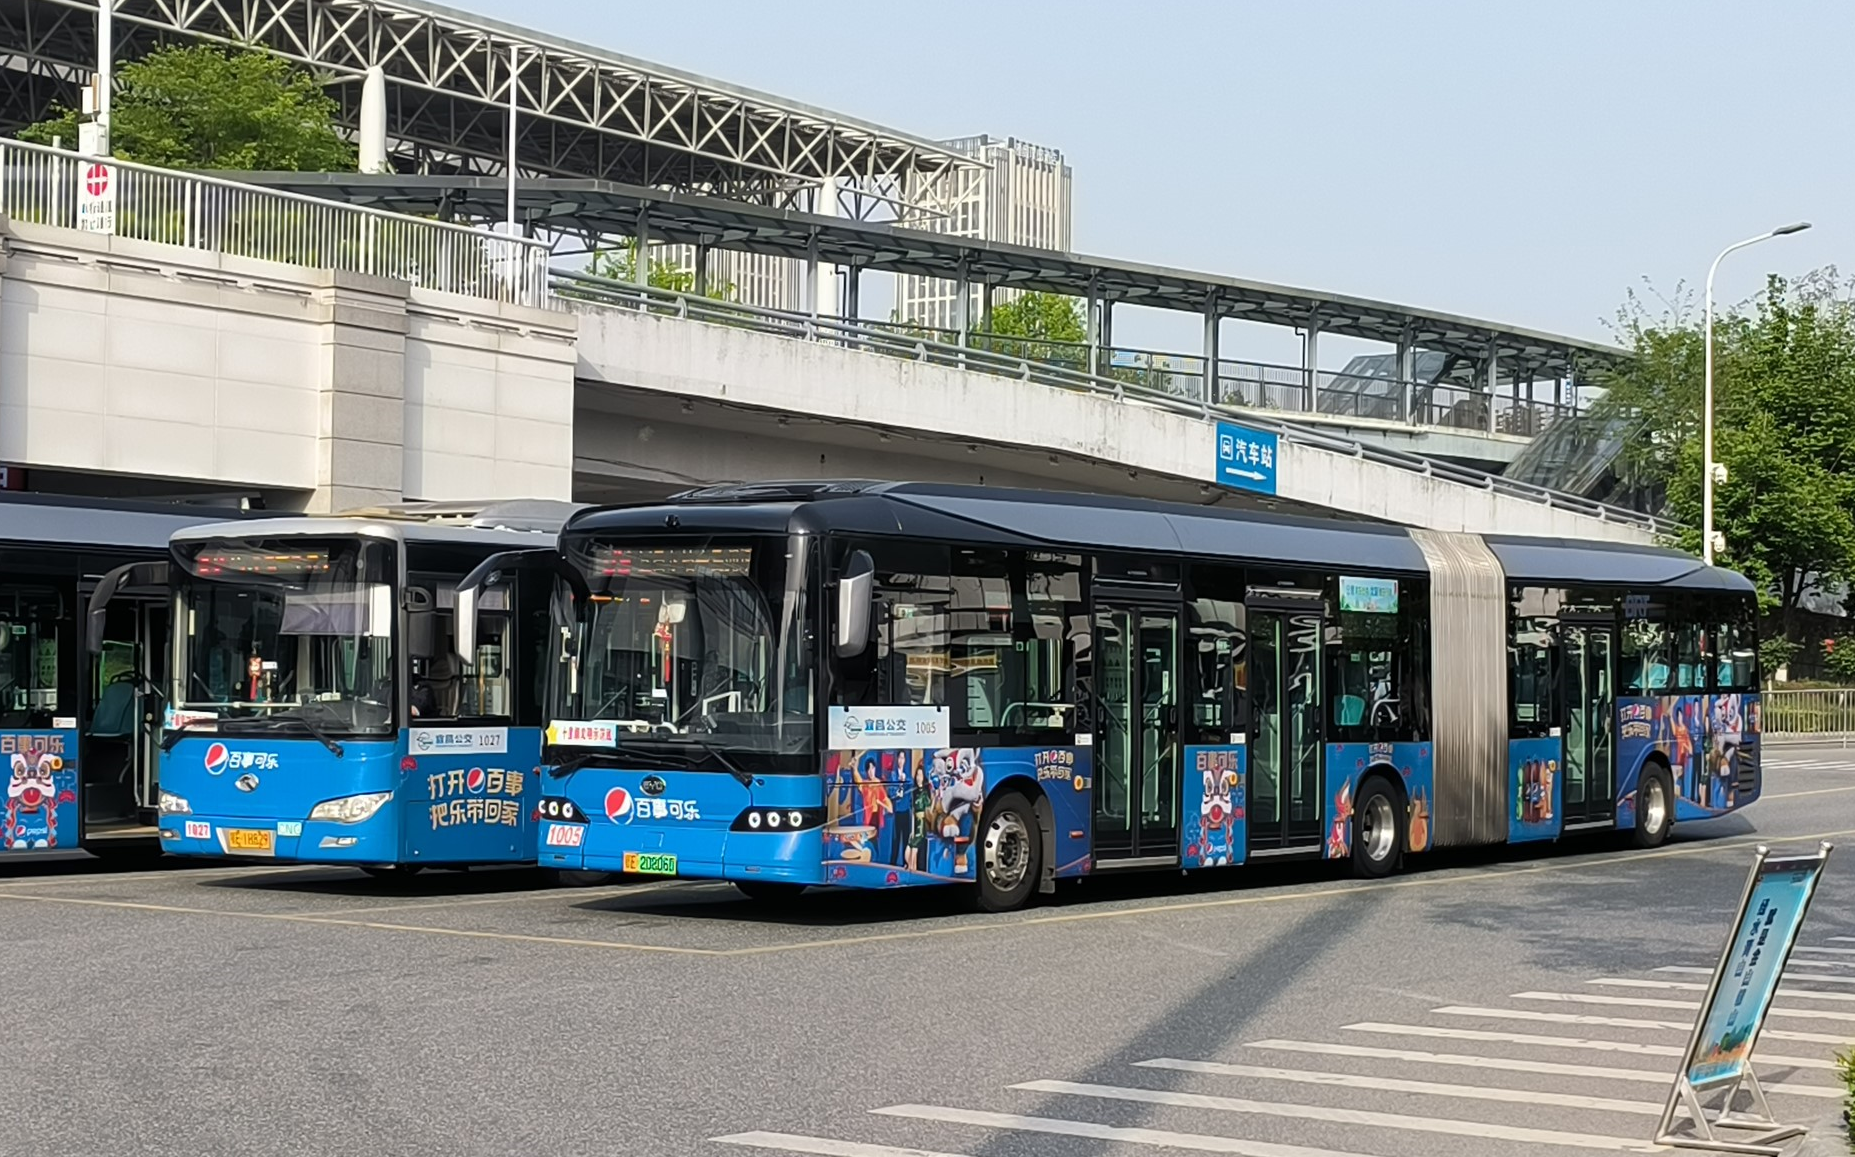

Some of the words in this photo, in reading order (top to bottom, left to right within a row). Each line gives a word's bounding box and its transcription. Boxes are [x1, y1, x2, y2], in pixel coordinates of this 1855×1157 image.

[1235, 438, 1273, 469] 汽车站
[864, 719, 906, 731] 宜昌公交
[916, 721, 936, 735] 1005
[479, 734, 500, 746] 1027
[228, 751, 279, 769] 百事可乐
[429, 798, 519, 831] 把乐带回家
[634, 798, 700, 820] 百事可乐
[187, 823, 209, 836] 1027
[550, 826, 582, 844] 1005
